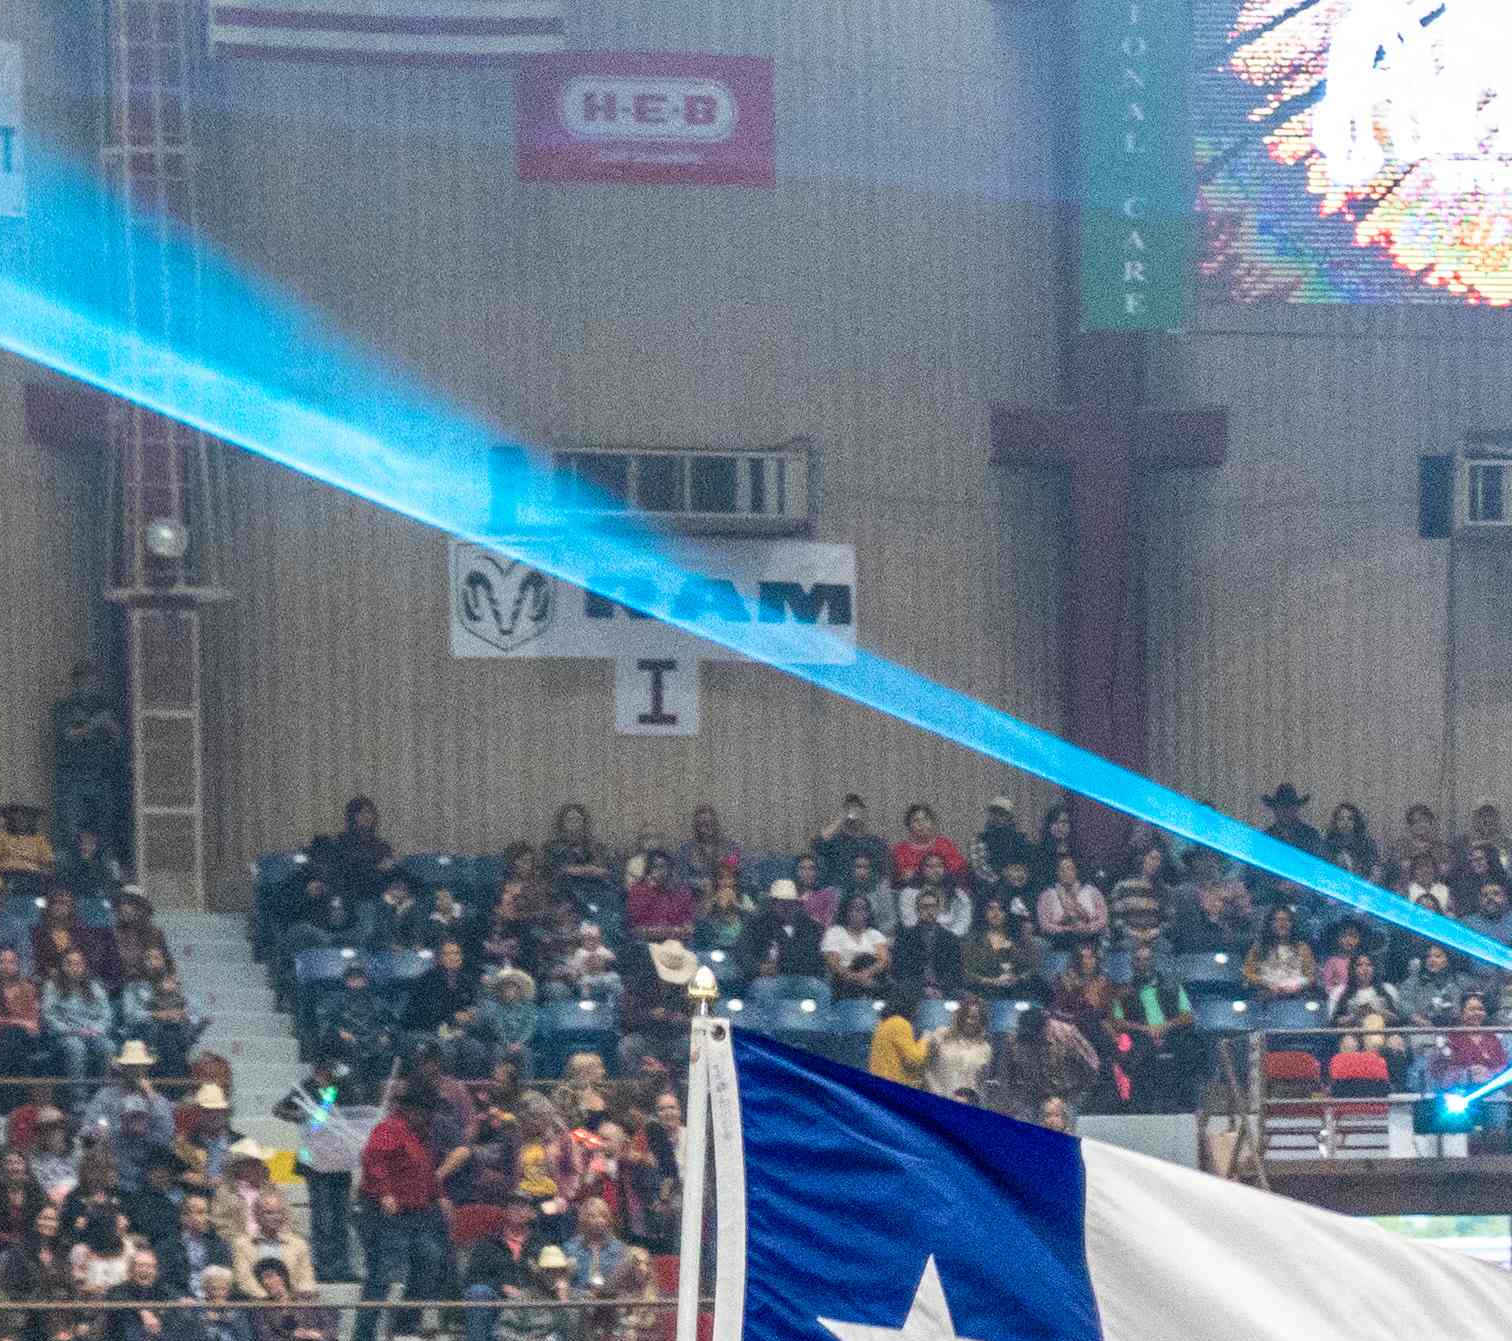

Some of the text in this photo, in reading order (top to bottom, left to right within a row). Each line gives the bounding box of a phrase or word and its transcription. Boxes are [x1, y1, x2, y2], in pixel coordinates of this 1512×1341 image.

[1121, 3, 1147, 153] IONAL
[583, 93, 718, 125] H-E-B
[584, 577, 853, 625] RAM
[636, 658, 678, 725] I
